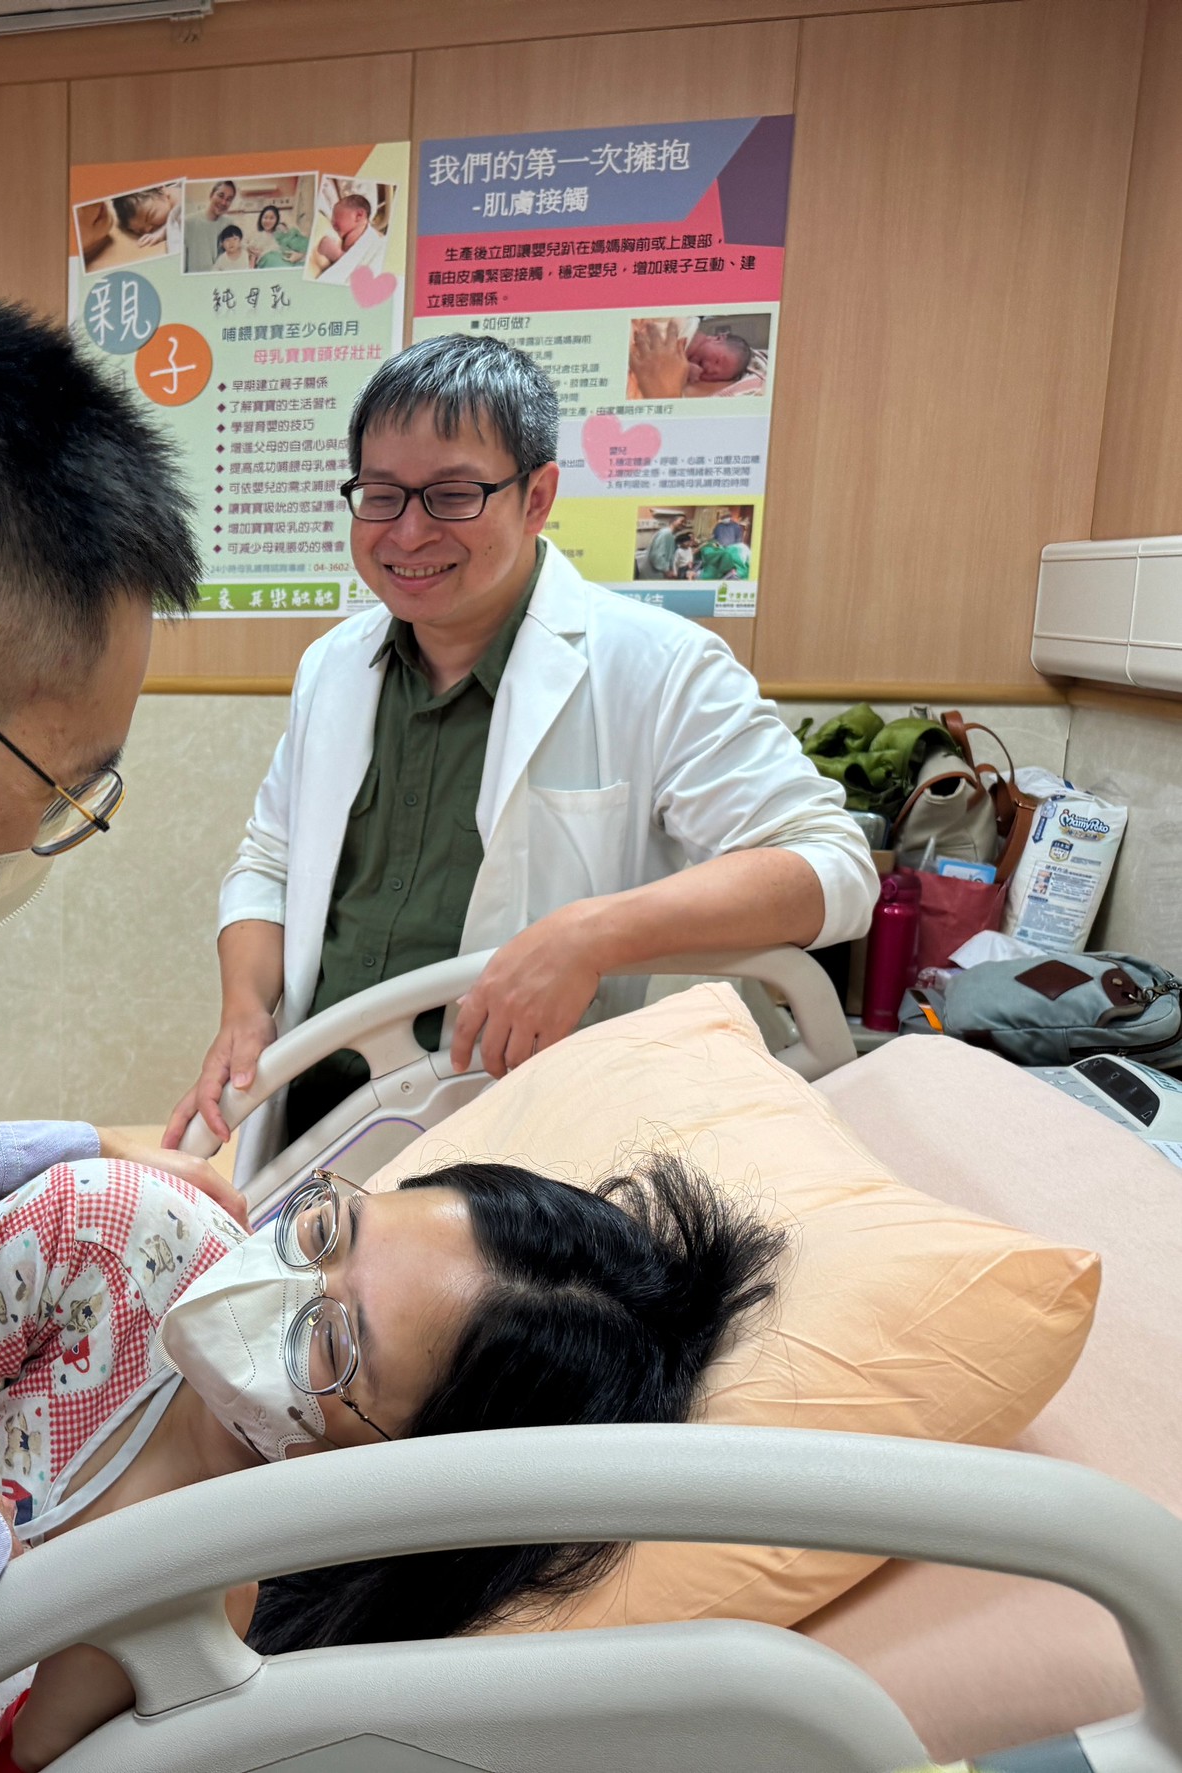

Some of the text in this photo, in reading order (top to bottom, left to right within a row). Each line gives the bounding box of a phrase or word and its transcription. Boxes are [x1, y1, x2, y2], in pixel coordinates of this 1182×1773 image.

[428, 138, 690, 187] 我們的第一次擁抱
[471, 186, 589, 218] -肌膚接觸
[212, 284, 291, 312] 純母乳
[427, 291, 508, 309] 立親密關係。
[89, 278, 152, 347] 親
[222, 320, 359, 342] 哺餵寶寶至少6個月
[149, 336, 197, 395] 子
[253, 343, 382, 365] 母乳寶寶頭好壯壯
[231, 376, 328, 393] 早期建立親子關係
[229, 397, 337, 414] 了解寶寶的生活習性
